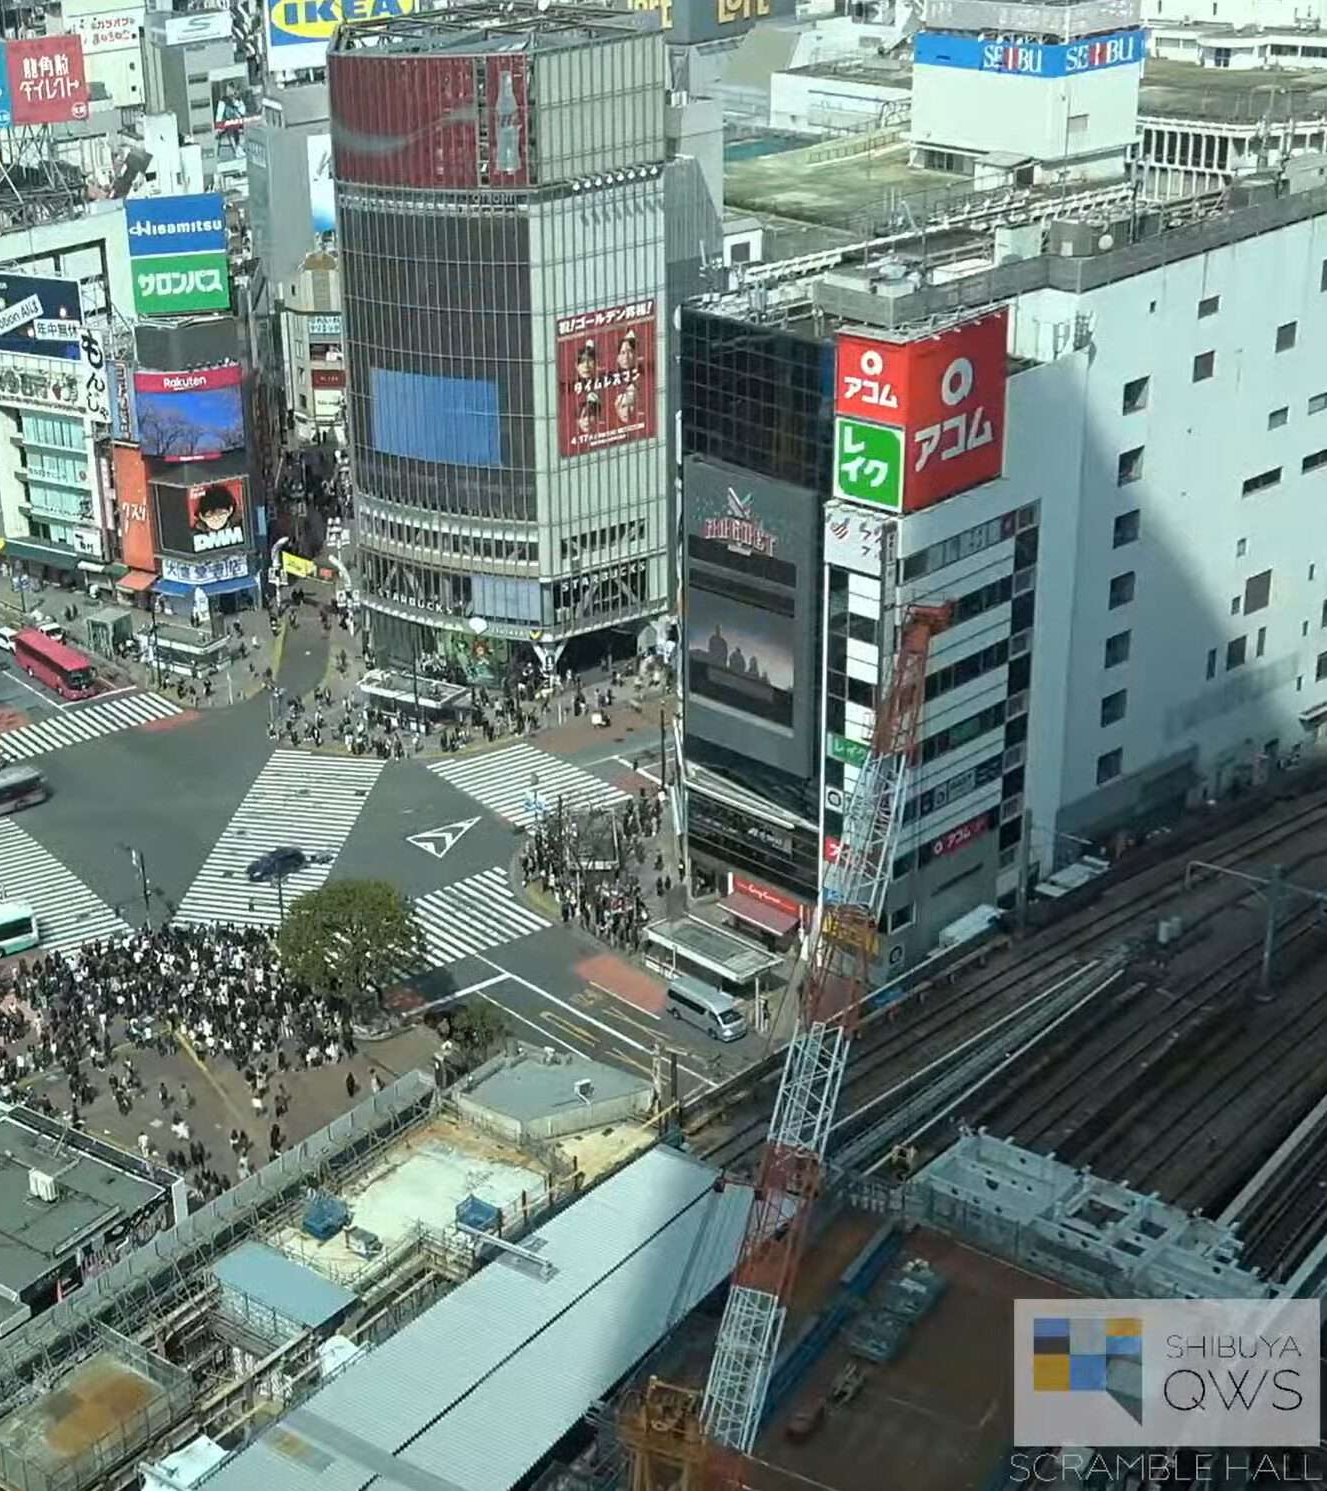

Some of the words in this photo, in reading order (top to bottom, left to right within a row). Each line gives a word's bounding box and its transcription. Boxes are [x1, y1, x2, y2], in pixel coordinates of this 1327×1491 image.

[284, 0, 403, 25] IKEA
[984, 45, 1042, 73] SEIBU
[1066, 37, 1134, 72] SEIBU
[128, 220, 222, 237] Hisamitsu
[138, 269, 223, 297] サロンパス
[37, 322, 77, 338] 年中無休
[81, 329, 110, 420] もんじゃ
[163, 376, 207, 389] Rakuten
[574, 369, 641, 395] タイムレスマン
[844, 376, 898, 408] アコム
[844, 426, 865, 453] レ
[914, 406, 994, 472] アコム
[841, 457, 889, 487] イク
[193, 526, 244, 553] DMM
[561, 560, 646, 592] STARBUCKS
[378, 586, 453, 615] STARBUCKS
